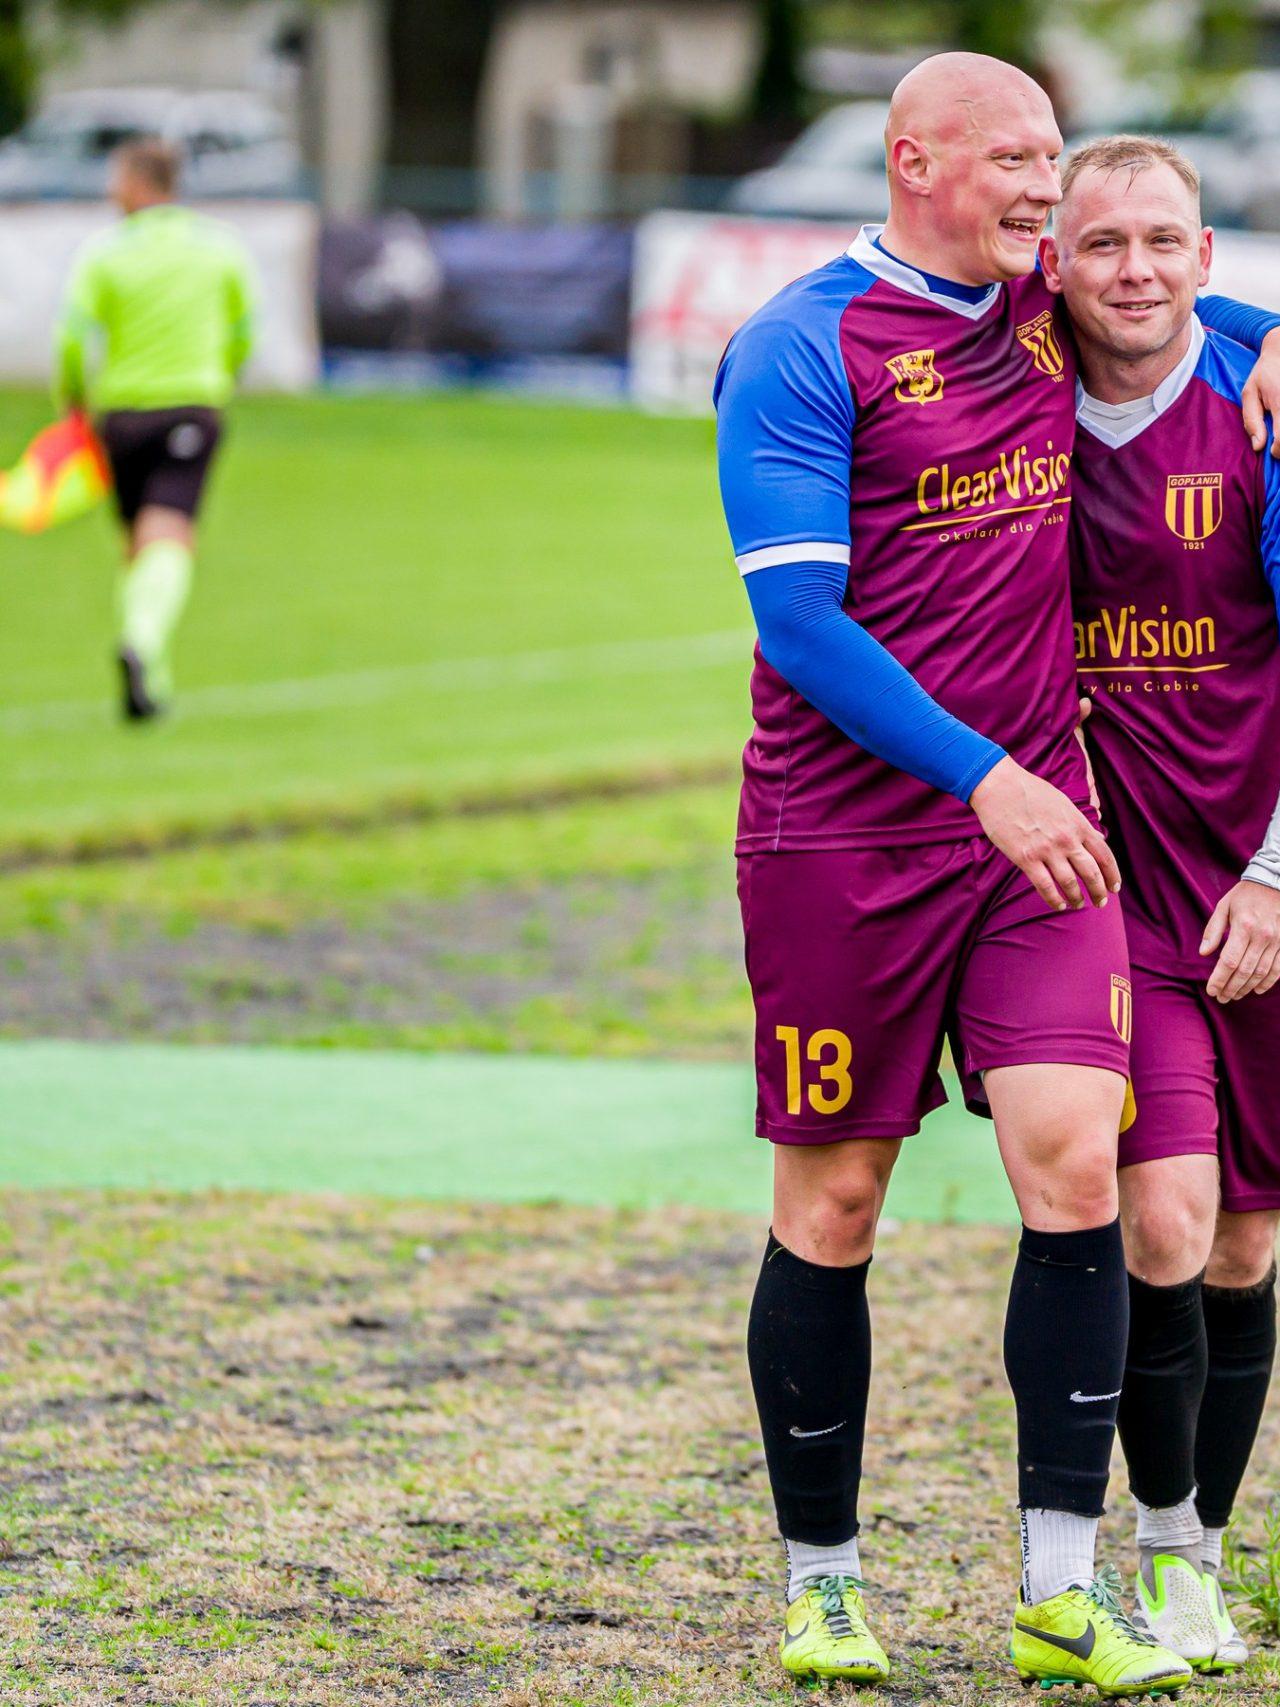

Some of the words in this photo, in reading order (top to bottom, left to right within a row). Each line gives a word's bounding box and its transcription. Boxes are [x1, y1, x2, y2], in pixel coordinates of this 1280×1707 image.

[1017, 312, 1051, 337] GOPLANIA
[917, 440, 1072, 514] ClearVisio
[1170, 476, 1219, 486] GOPLANIA
[938, 528, 1001, 543] Okulary
[1009, 522, 1034, 534] dla
[1183, 542, 1205, 550] 1921
[1073, 605, 1215, 659] arVision
[1107, 682, 1132, 693] dla
[1143, 681, 1199, 693] Ciebie
[775, 1024, 852, 1115] 13
